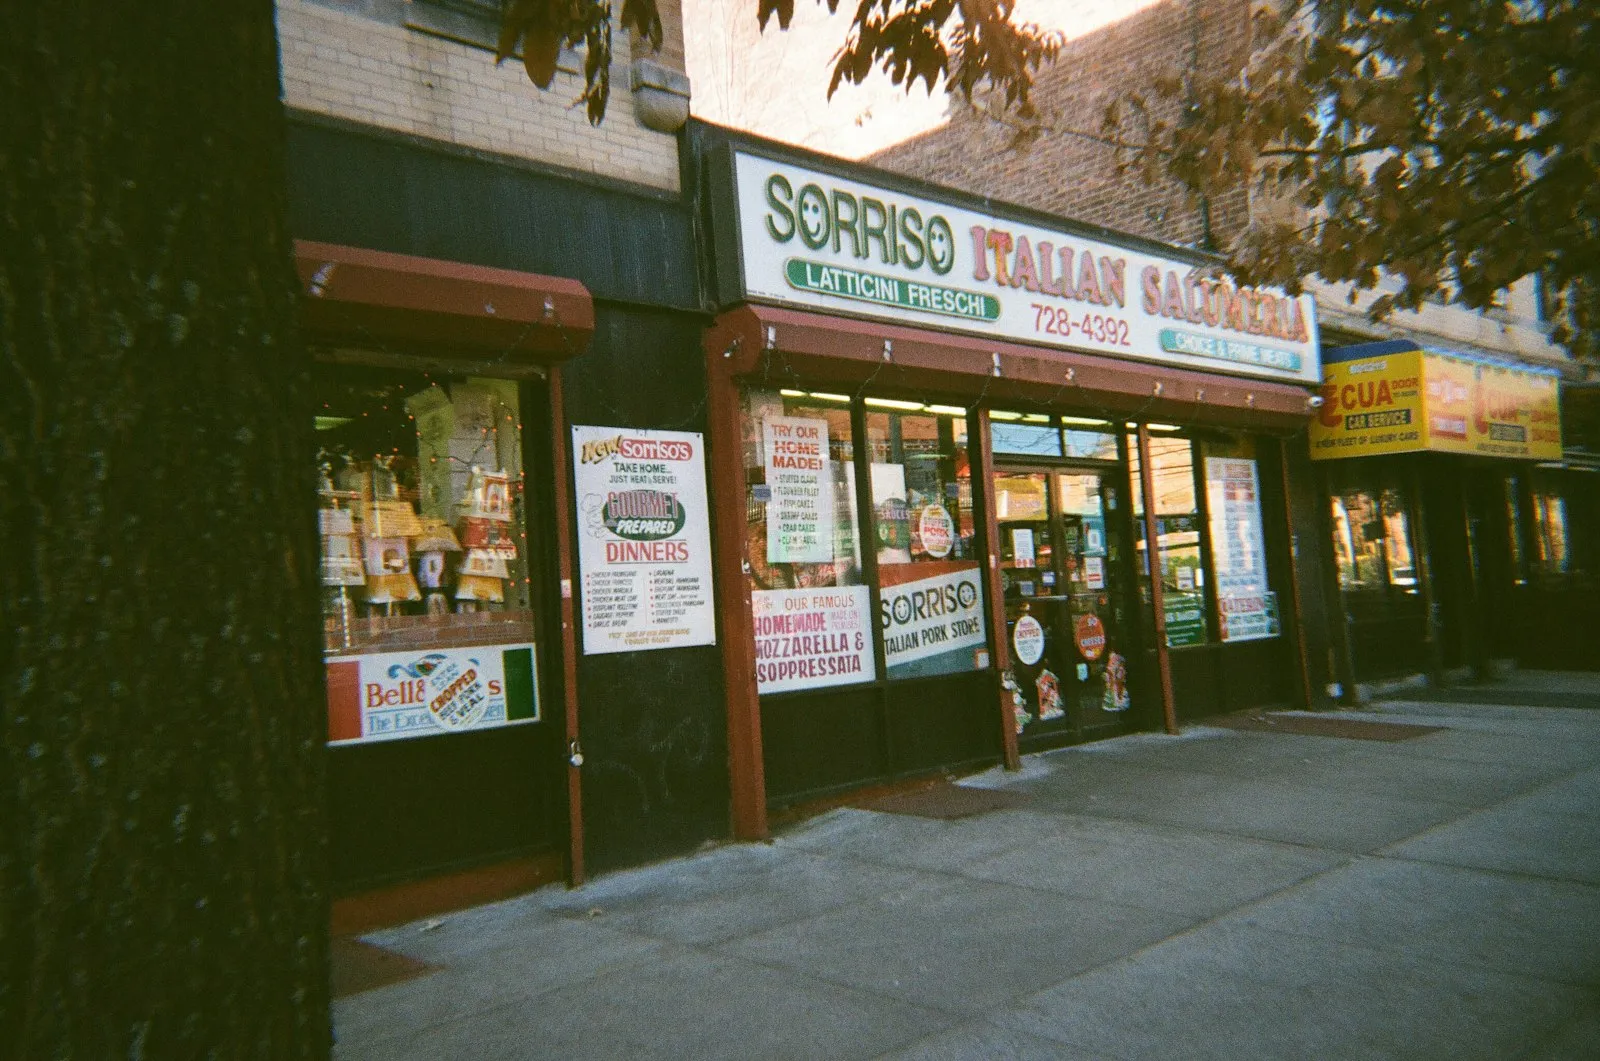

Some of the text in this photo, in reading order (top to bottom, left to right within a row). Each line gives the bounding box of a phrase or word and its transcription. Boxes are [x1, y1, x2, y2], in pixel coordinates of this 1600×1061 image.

[765, 173, 955, 276] SORRISO
[970, 225, 1126, 308] ITALIAN
[805, 263, 985, 317] LATTICINI FRESCHI
[1031, 303, 1132, 346] 728-4392
[772, 424, 818, 438] TRY OUR
[774, 440, 820, 456] HOME
[614, 463, 637, 473] TAKE
[772, 455, 823, 470] MADE!
[609, 475, 628, 483] JUST
[630, 475, 647, 483] HEAT
[653, 475, 676, 484] SERVE!
[608, 491, 679, 519] GOURMET
[616, 519, 675, 534] PREPARED
[606, 541, 689, 562] DINNERS
[785, 598, 808, 611] OUR
[813, 594, 855, 608] FAMOUS
[881, 581, 977, 629] SORRISO
[753, 612, 827, 636] HOMEMADE
[922, 624, 948, 646] PORK
[951, 617, 980, 638] STORE
[855, 631, 864, 651] &
[757, 654, 862, 683] SOPPRESSATA
